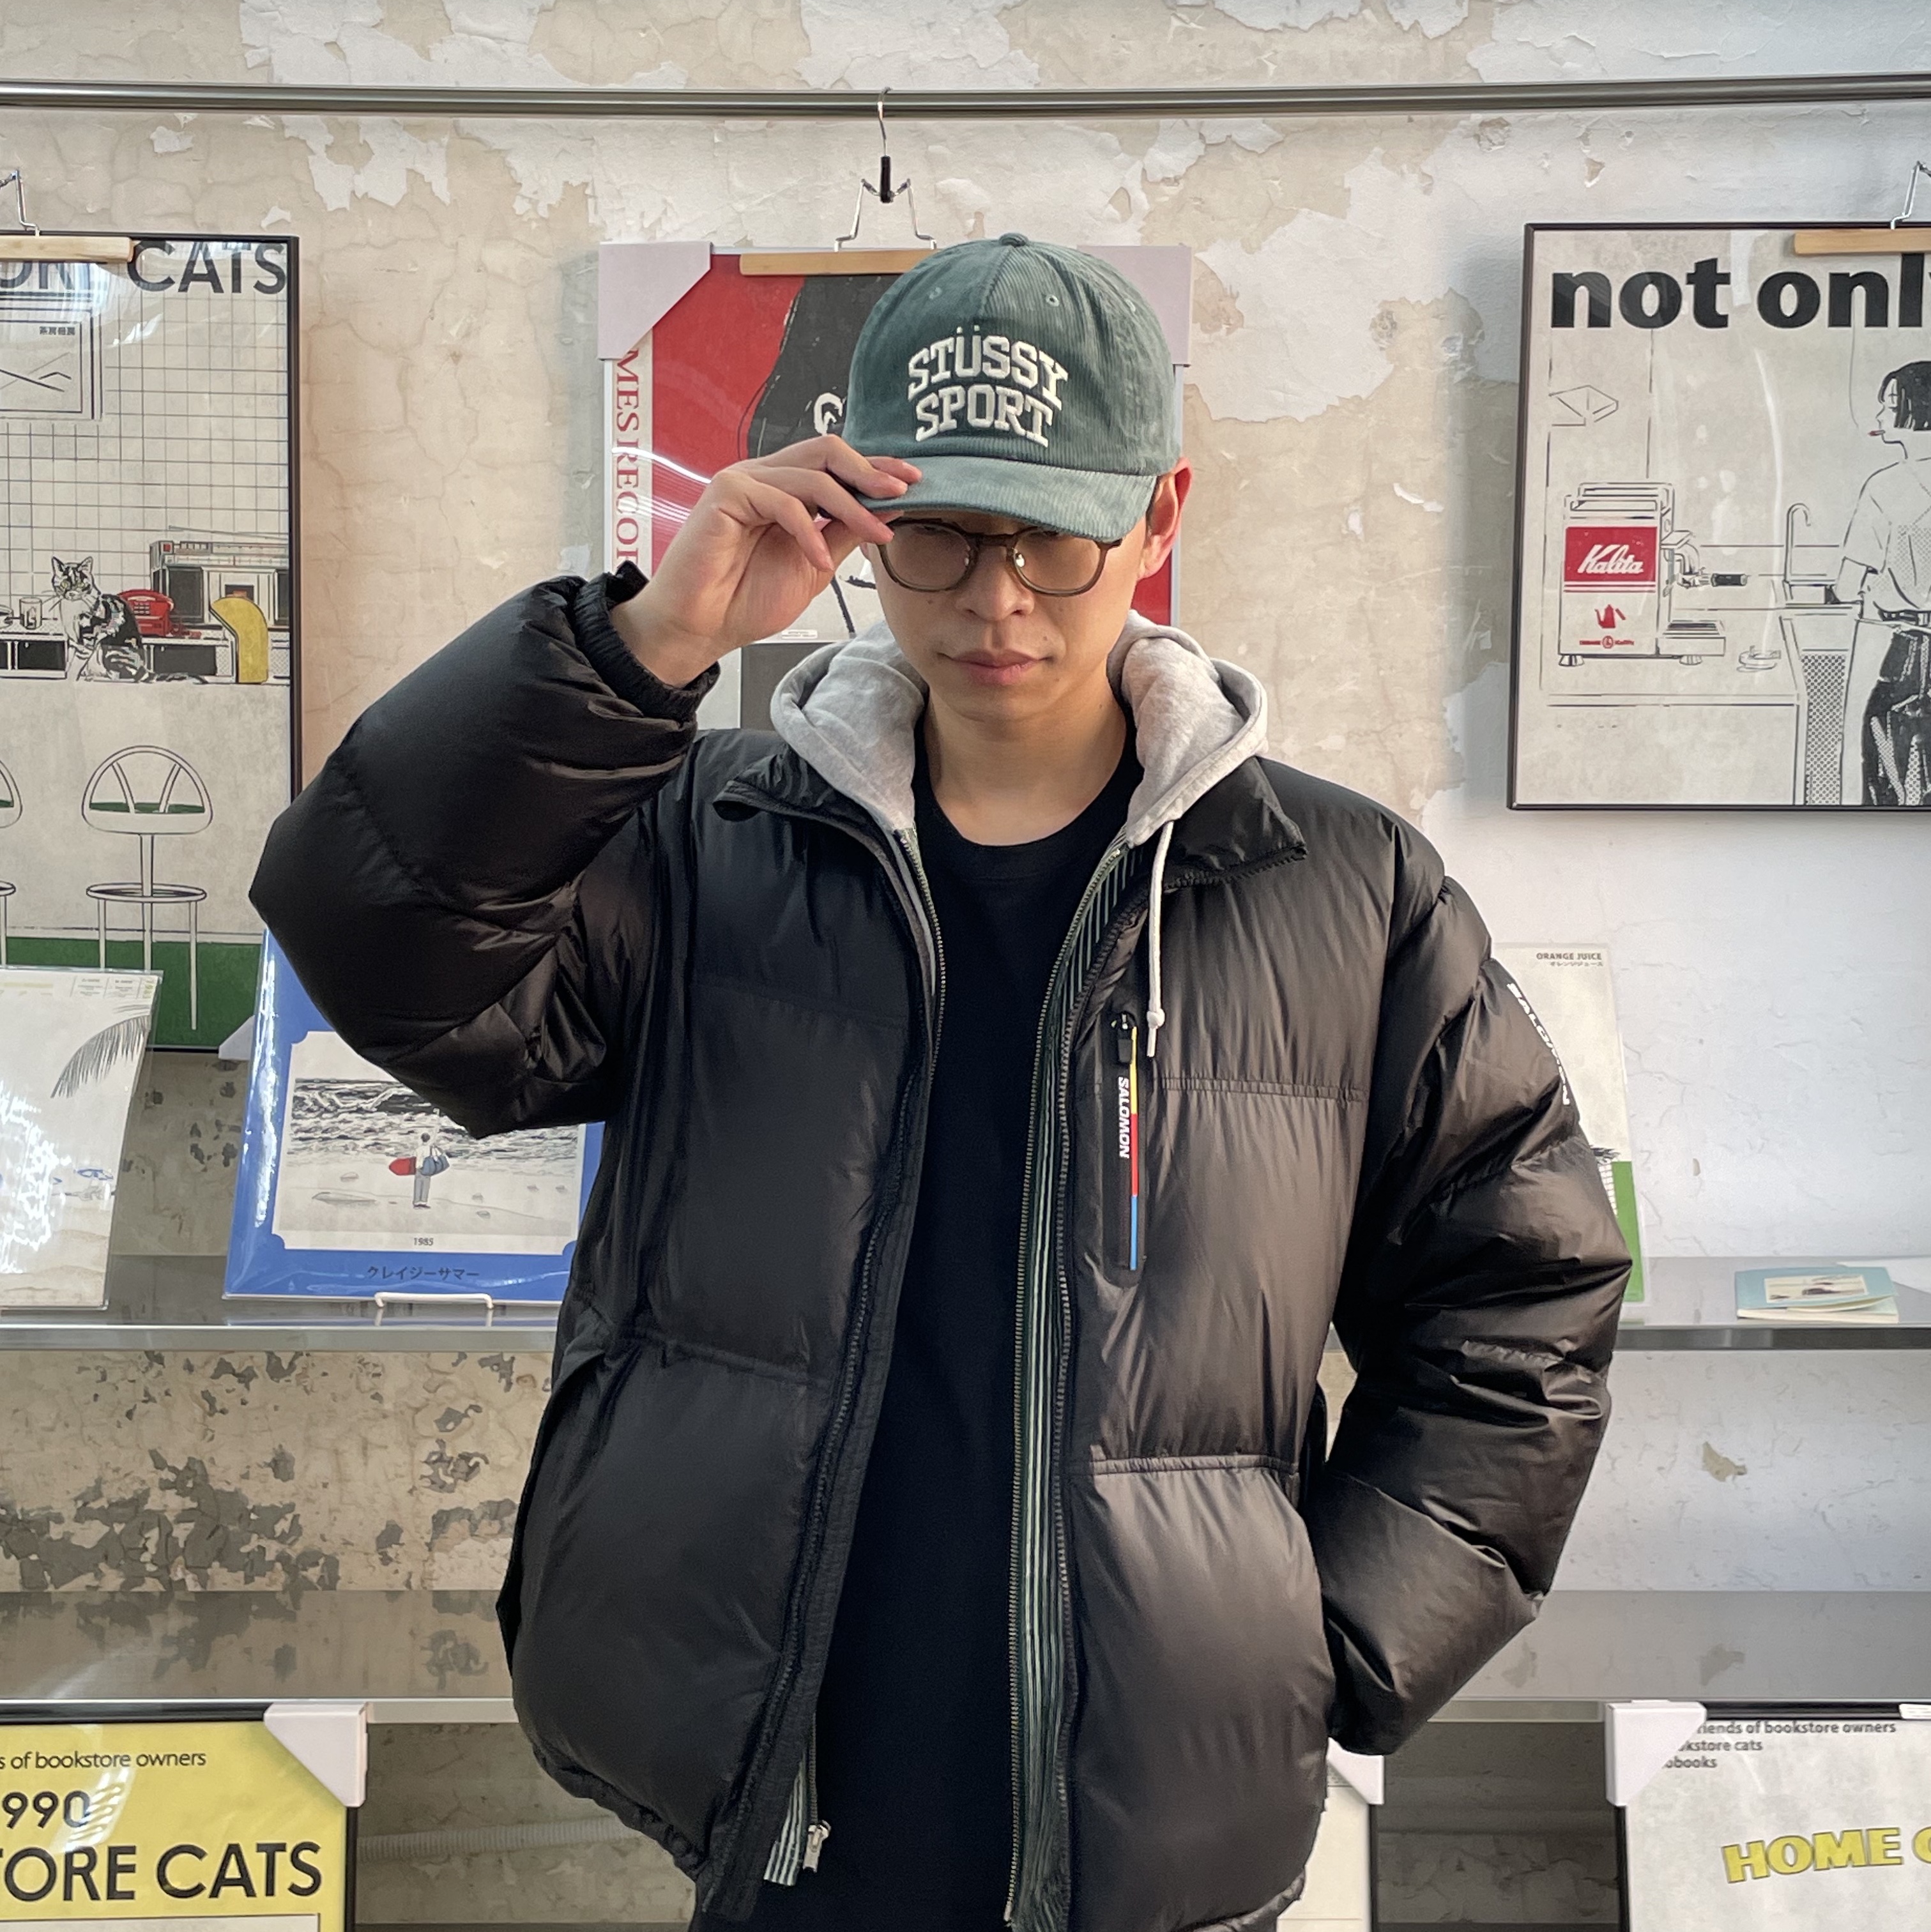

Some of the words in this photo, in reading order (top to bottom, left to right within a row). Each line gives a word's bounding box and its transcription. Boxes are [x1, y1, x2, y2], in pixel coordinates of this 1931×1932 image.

[128, 240, 287, 294] CATS
[1551, 257, 1730, 330] not
[1757, 253, 1931, 329] onl
[908, 324, 1069, 411] STÜSSY
[915, 384, 1053, 448] SPORT
[1577, 544, 1644, 574] Kalita
[1118, 1076, 1130, 1159] SALOMON
[367, 1266, 480, 1281] クレイジーサマー
[1734, 1740, 1763, 1751] cats
[1746, 1719, 1762, 1733] of
[1764, 1720, 1838, 1733] bookstore
[1842, 1722, 1897, 1733] owners
[11, 1751, 33, 1768] of
[36, 1751, 132, 1768] bookstore
[136, 1751, 206, 1767] owners
[0, 1844, 137, 1901] ORE
[156, 1841, 322, 1899] CATS
[1721, 1827, 1904, 1883] HOME
